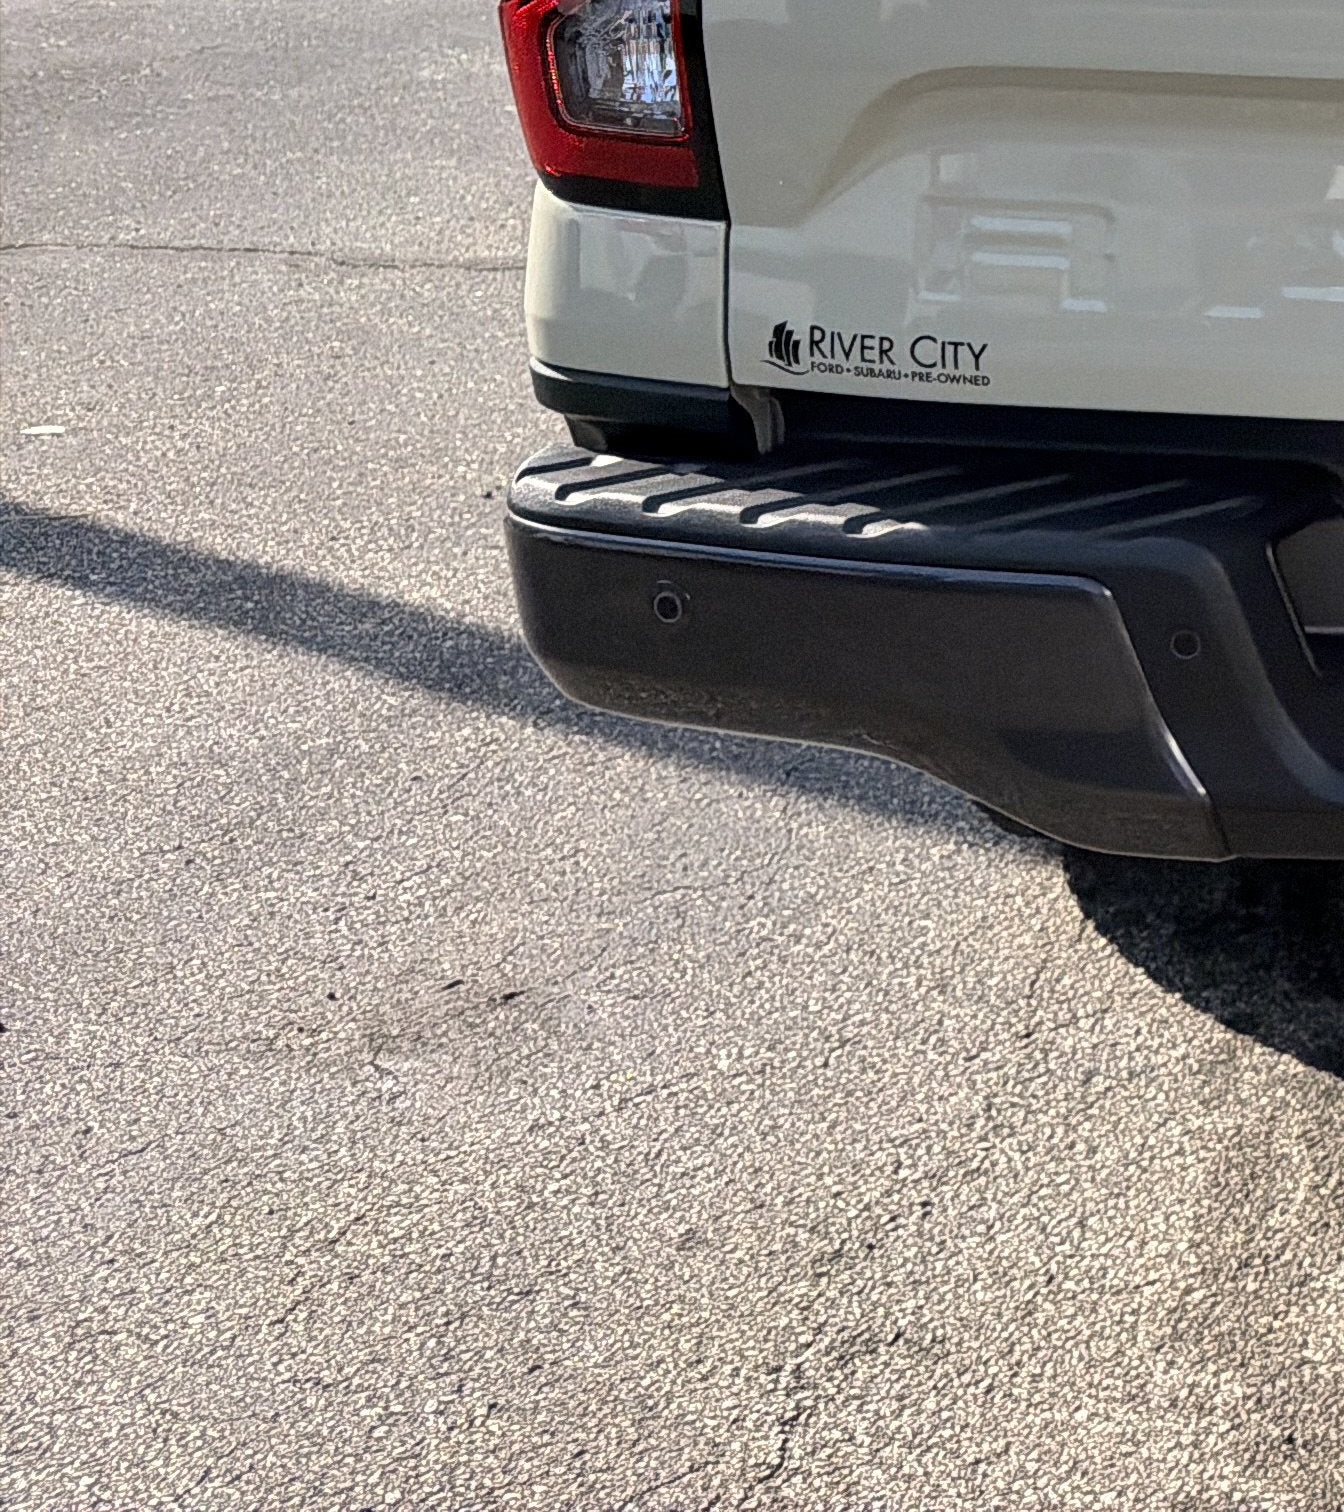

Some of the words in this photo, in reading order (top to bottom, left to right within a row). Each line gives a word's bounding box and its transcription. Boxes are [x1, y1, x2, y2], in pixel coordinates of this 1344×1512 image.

[809, 325, 896, 365] RIVER
[910, 335, 988, 371] CITY
[911, 371, 990, 387] PRE-OWNED
